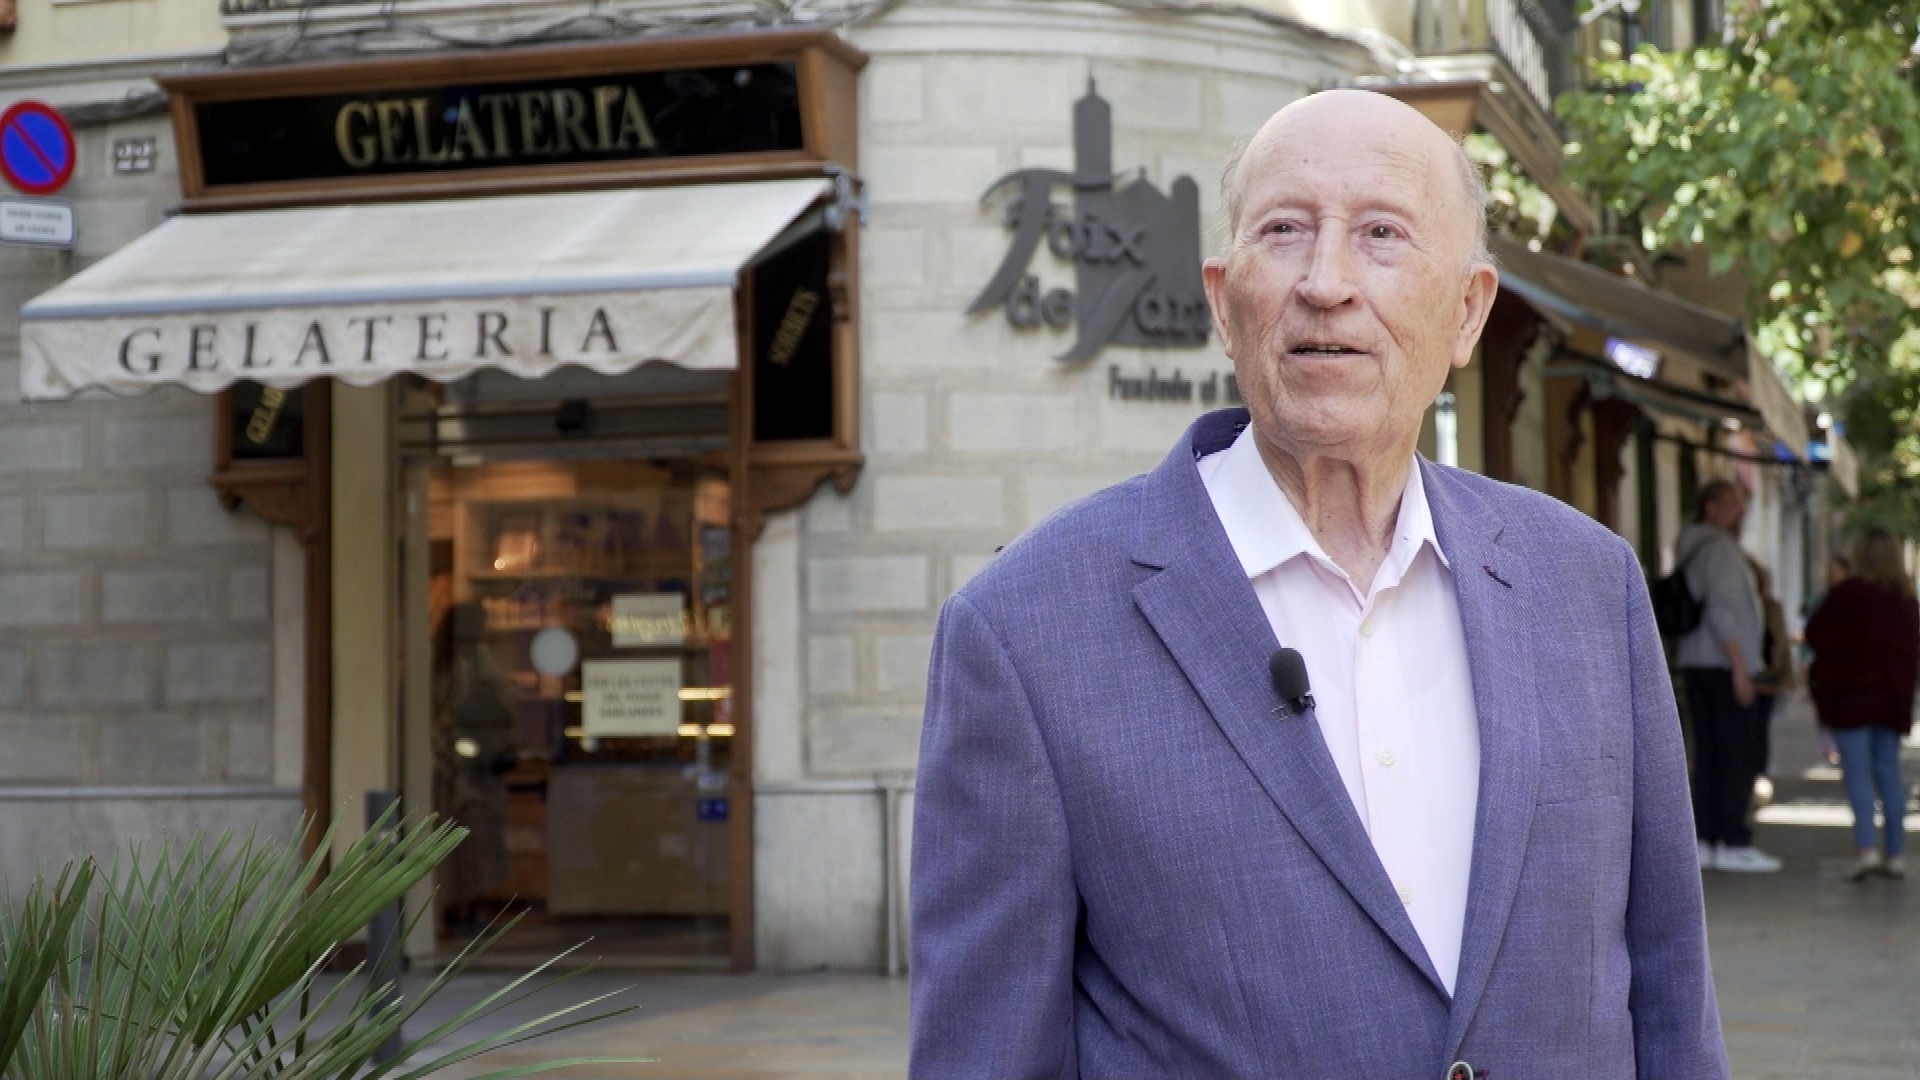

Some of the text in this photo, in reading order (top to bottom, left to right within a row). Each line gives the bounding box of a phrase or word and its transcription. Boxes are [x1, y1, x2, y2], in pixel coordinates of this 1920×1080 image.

[335, 85, 656, 168] GELATERIA
[1005, 272, 1076, 330] de
[117, 305, 619, 376] GELATERIA
